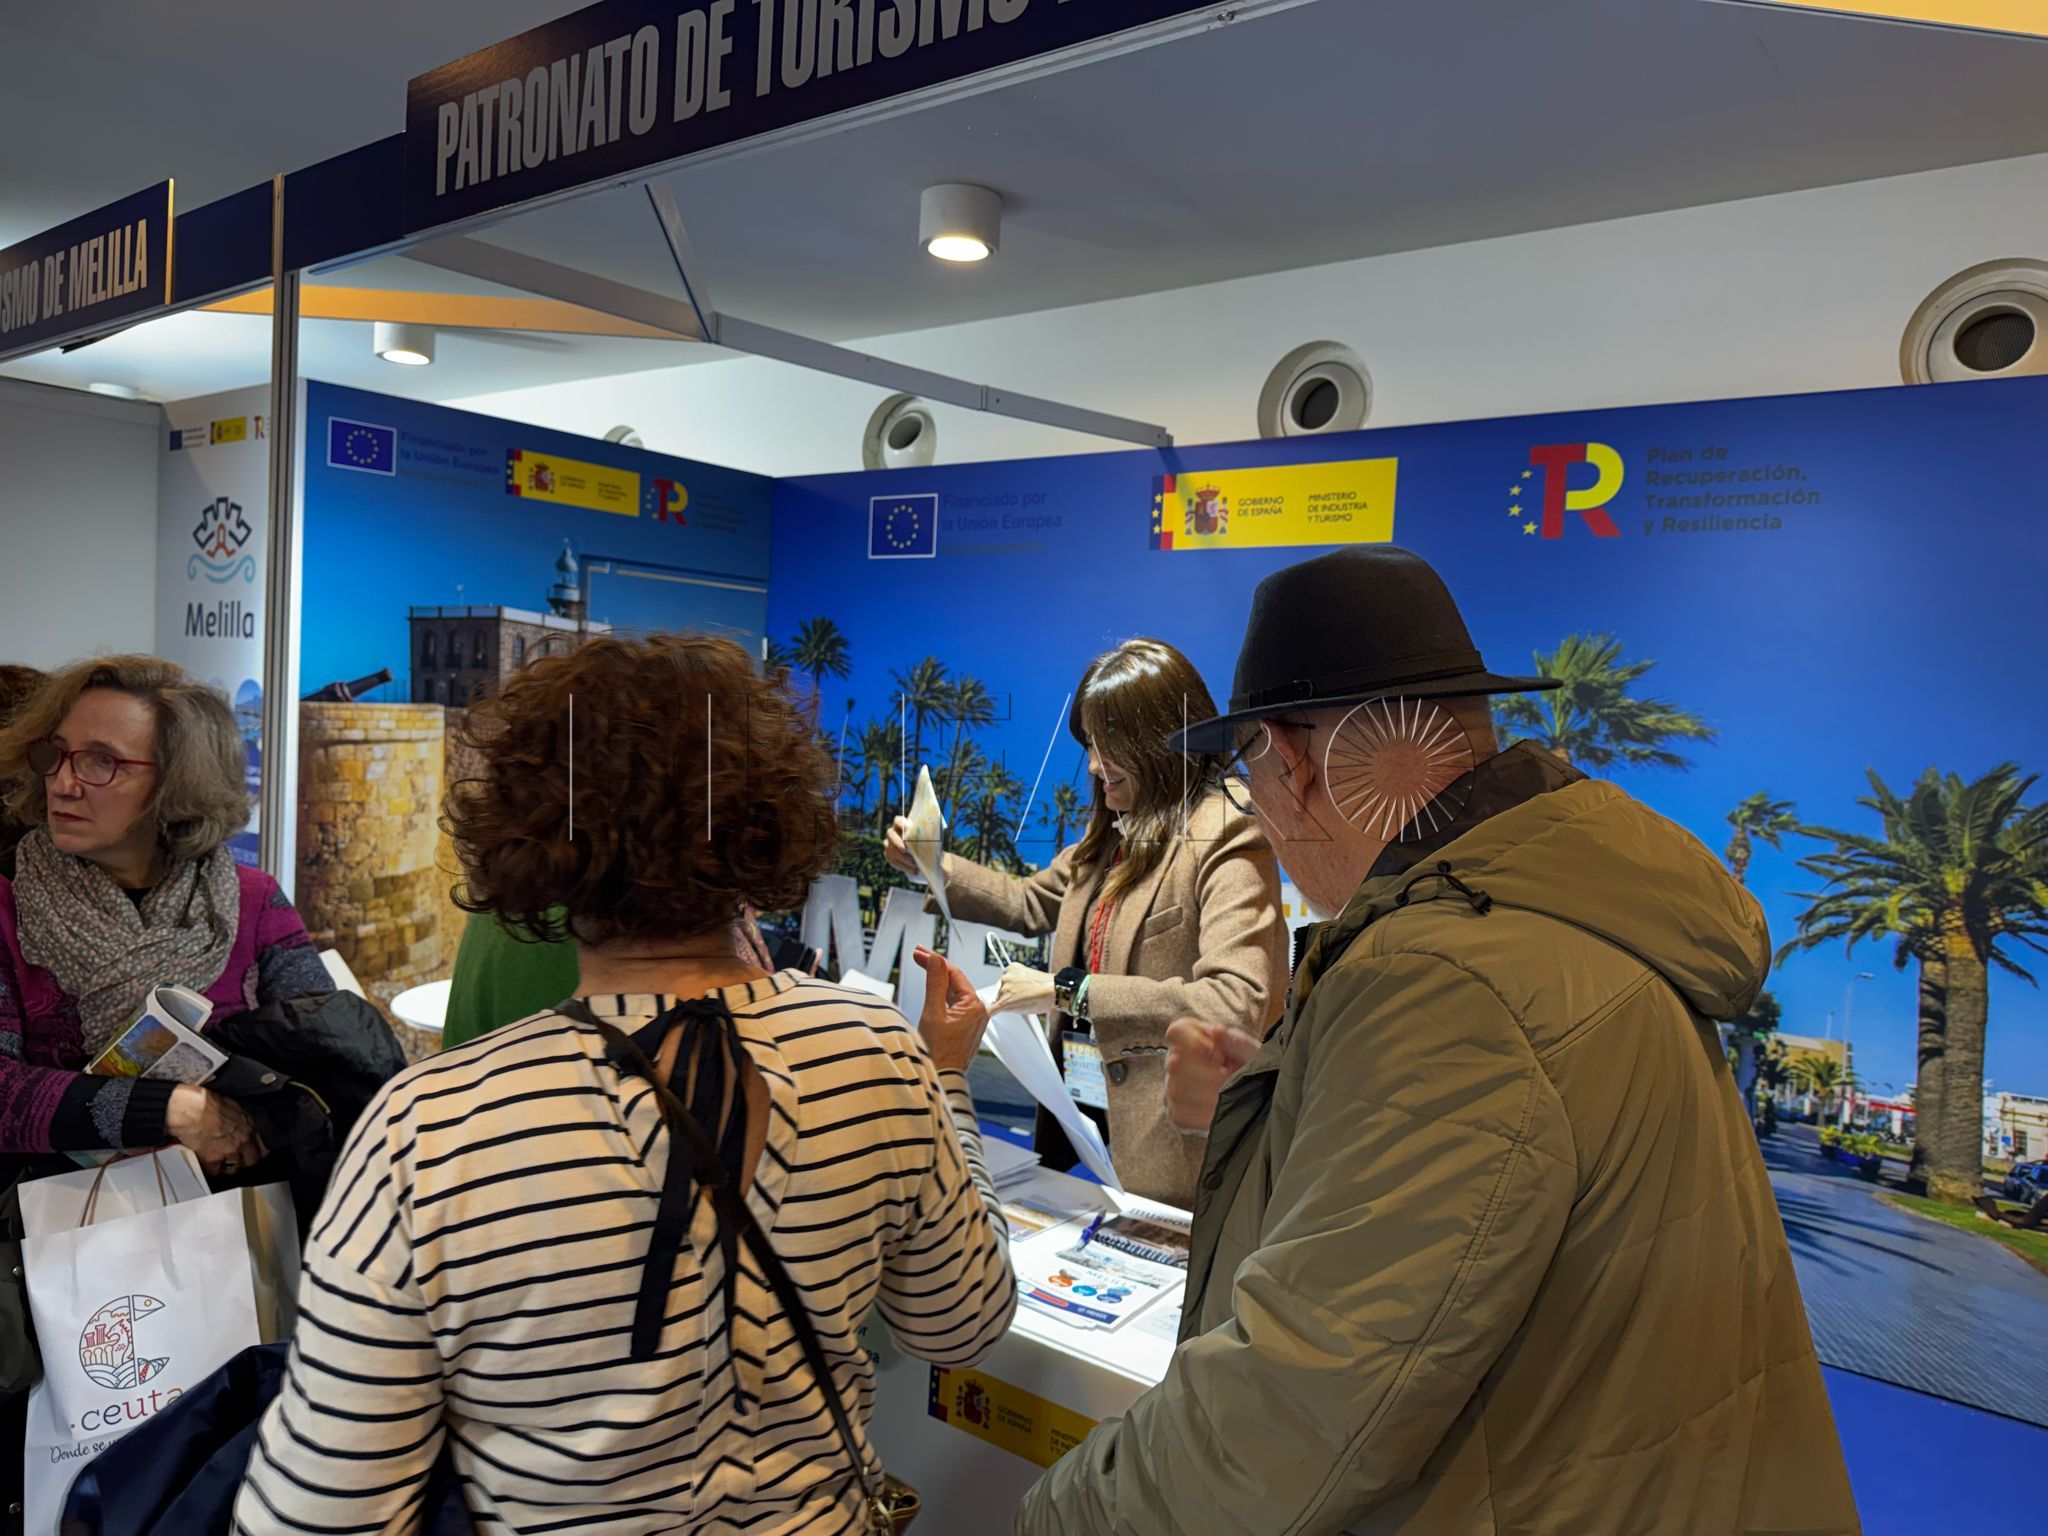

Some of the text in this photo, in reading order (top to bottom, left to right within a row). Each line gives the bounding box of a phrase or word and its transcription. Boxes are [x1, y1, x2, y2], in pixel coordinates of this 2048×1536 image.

[436, 0, 1029, 196] PATRONATO DE TURI
[42, 250, 66, 320] DE
[67, 218, 148, 312] MELILLA
[1646, 443, 1728, 463] Plan de
[1644, 464, 1808, 488] Recuperación,
[942, 492, 1049, 509] Financiado por
[1238, 496, 1285, 507] GOBIERNO
[1308, 492, 1358, 502] MINISTERIO
[1645, 487, 1821, 511] Transformación
[1237, 505, 1284, 518] DE ESPAÑA
[1307, 501, 1368, 514] DE INDUSTRIA
[956, 514, 998, 531] Unión
[1001, 514, 1063, 531] Europea
[1307, 513, 1353, 524] Y TURISMO
[1642, 514, 1783, 536] y Resiliencia
[185, 600, 255, 639] Melilla
[50, 1441, 91, 1464] Donde
[92, 1440, 107, 1454] se
